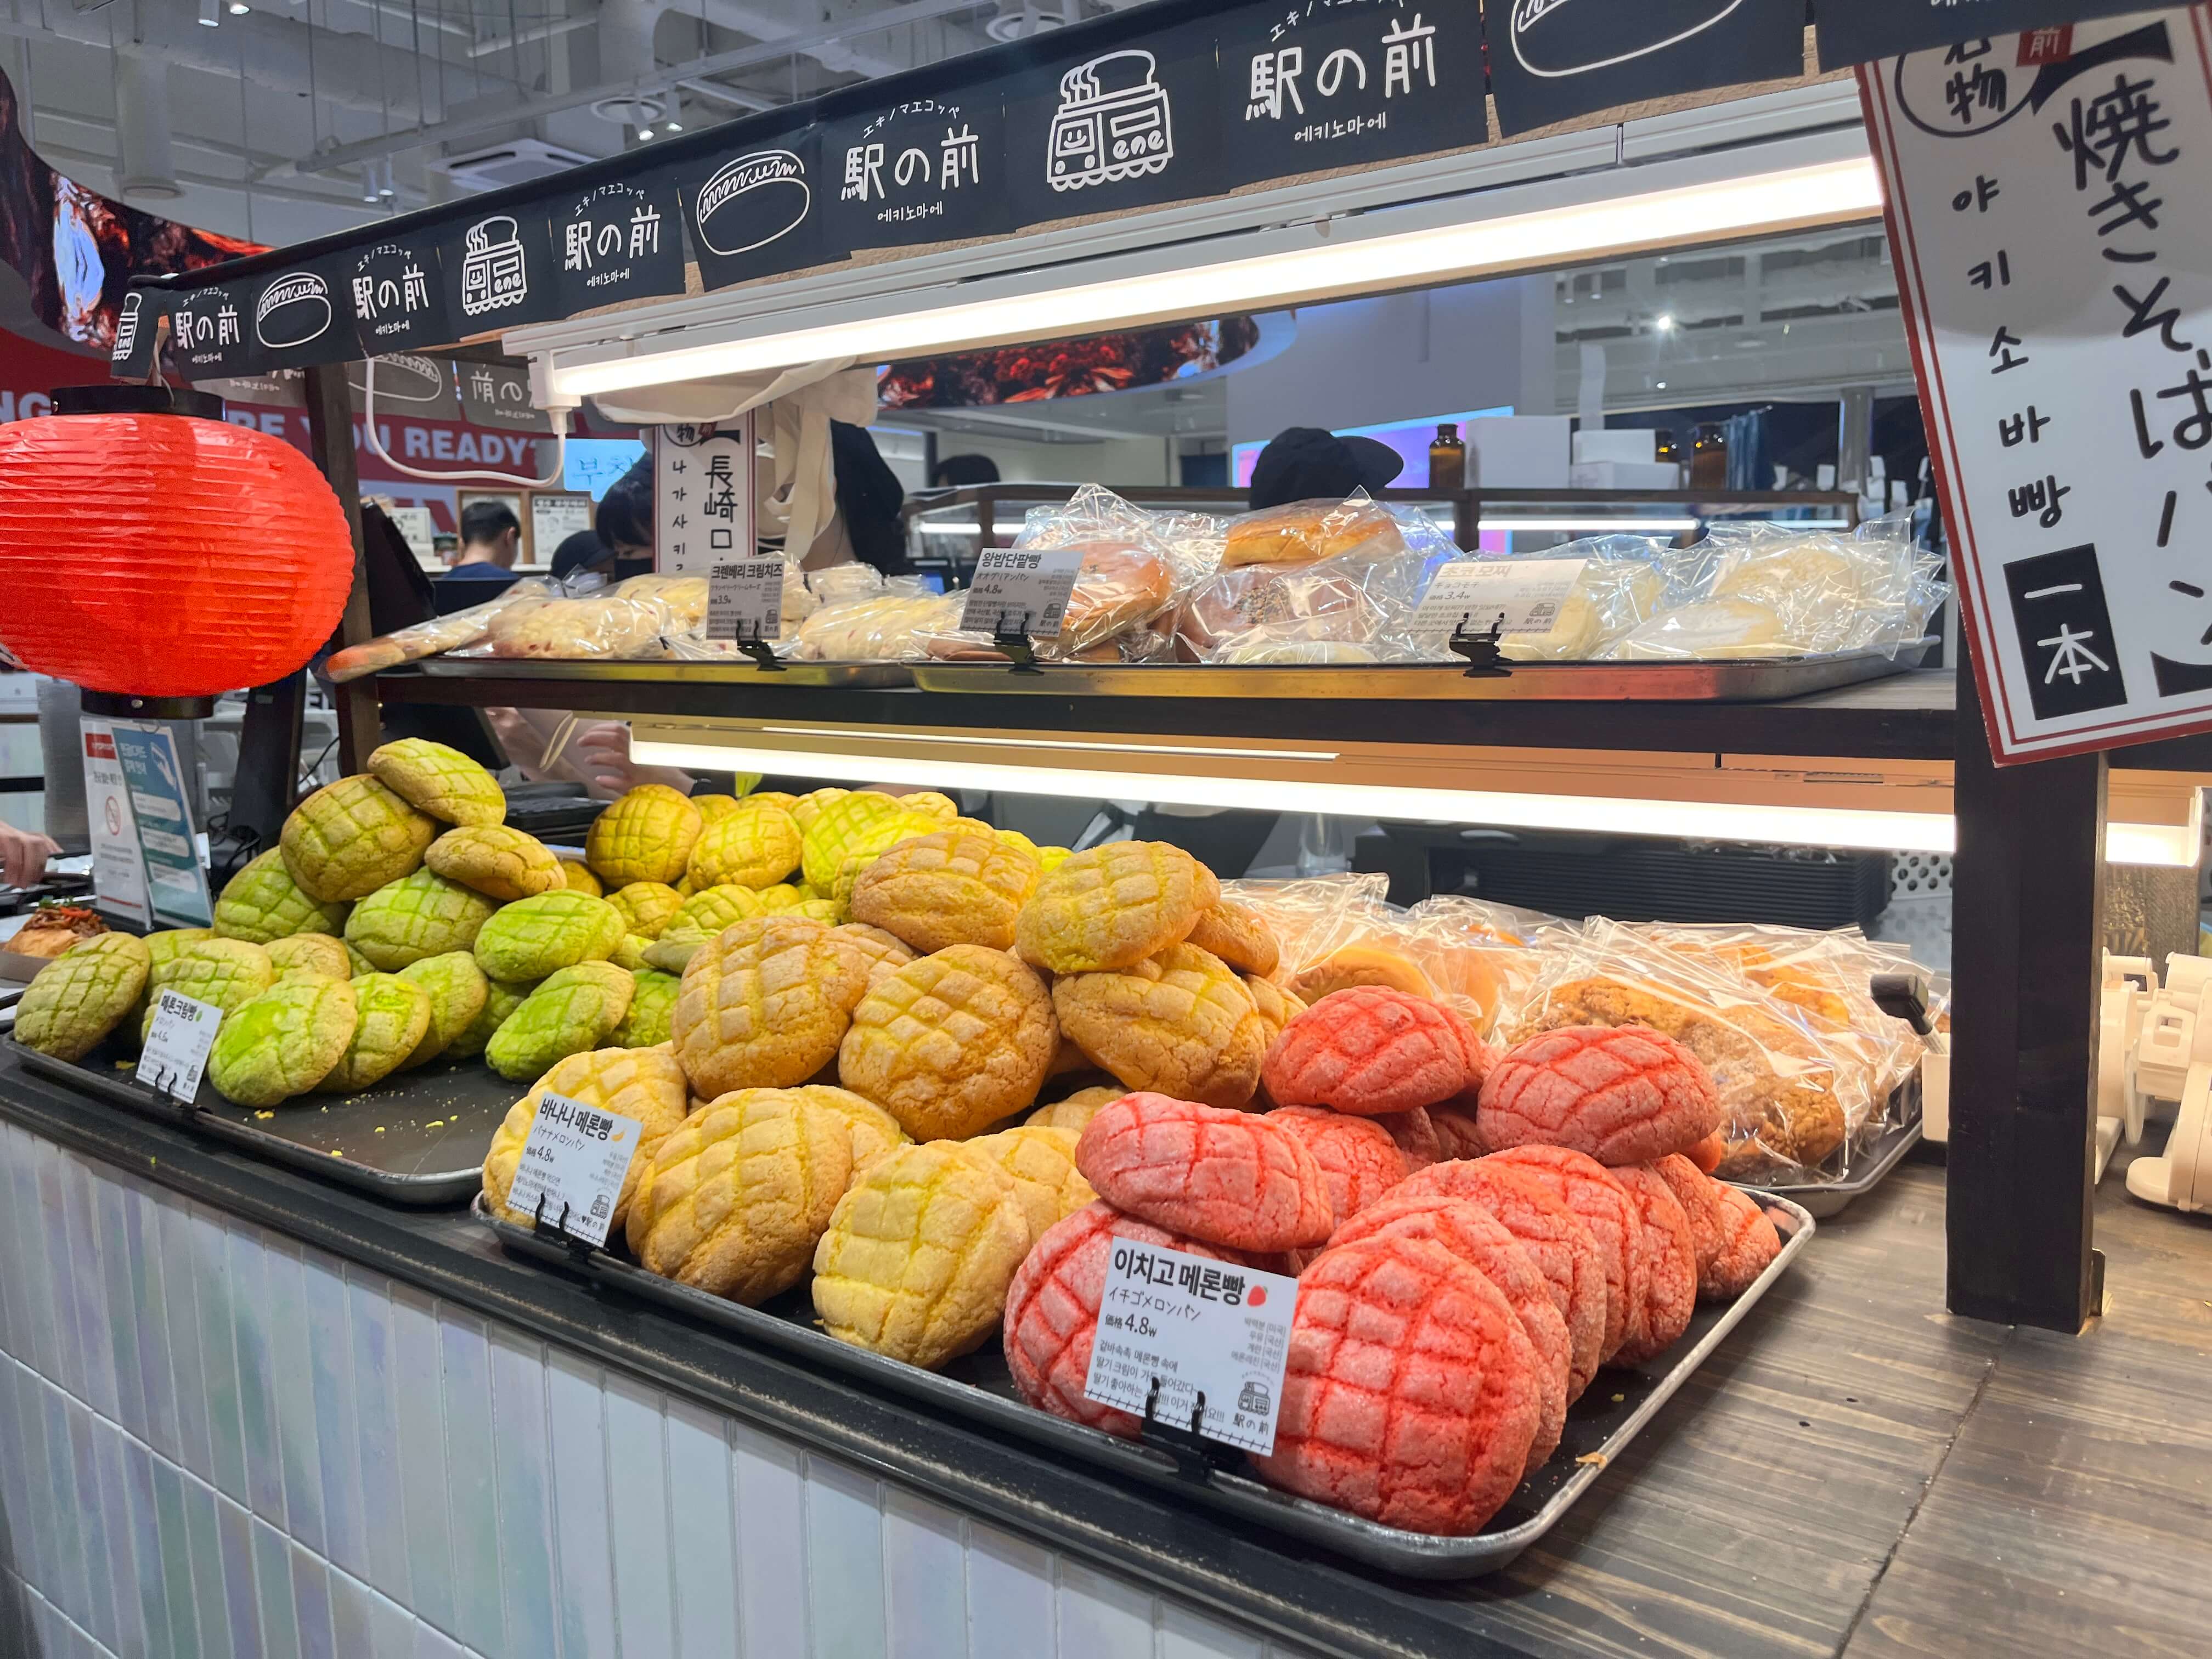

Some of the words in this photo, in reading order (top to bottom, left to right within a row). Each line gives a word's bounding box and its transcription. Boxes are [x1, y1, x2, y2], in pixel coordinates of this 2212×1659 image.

[1245, 13, 1436, 120] 駅の前
[1294, 111, 1386, 142] 에키노마에
[840, 123, 979, 201] 駅の前
[877, 200, 943, 222] 에키노마에
[565, 204, 661, 271] 駅の前
[352, 263, 429, 320] 駅の前
[586, 267, 630, 287] 에키노마에
[175, 304, 240, 349] 駅の前
[2053, 74, 2212, 645] 焼きそば
[746, 563, 782, 579] 크림치즈
[982, 551, 1041, 569] 왕밤단팥빵
[2024, 583, 2110, 685] 一本
[539, 1097, 576, 1128] 바나나
[574, 1110, 613, 1141] 메론빵
[1114, 1248, 1175, 1287] 이치고
[1178, 1264, 1246, 1306] 메론빵
[1109, 1286, 1201, 1321] イチゴメロンパン
[1124, 1313, 1158, 1338] 4.8w
[1233, 1412, 1270, 1436] 駅の前
